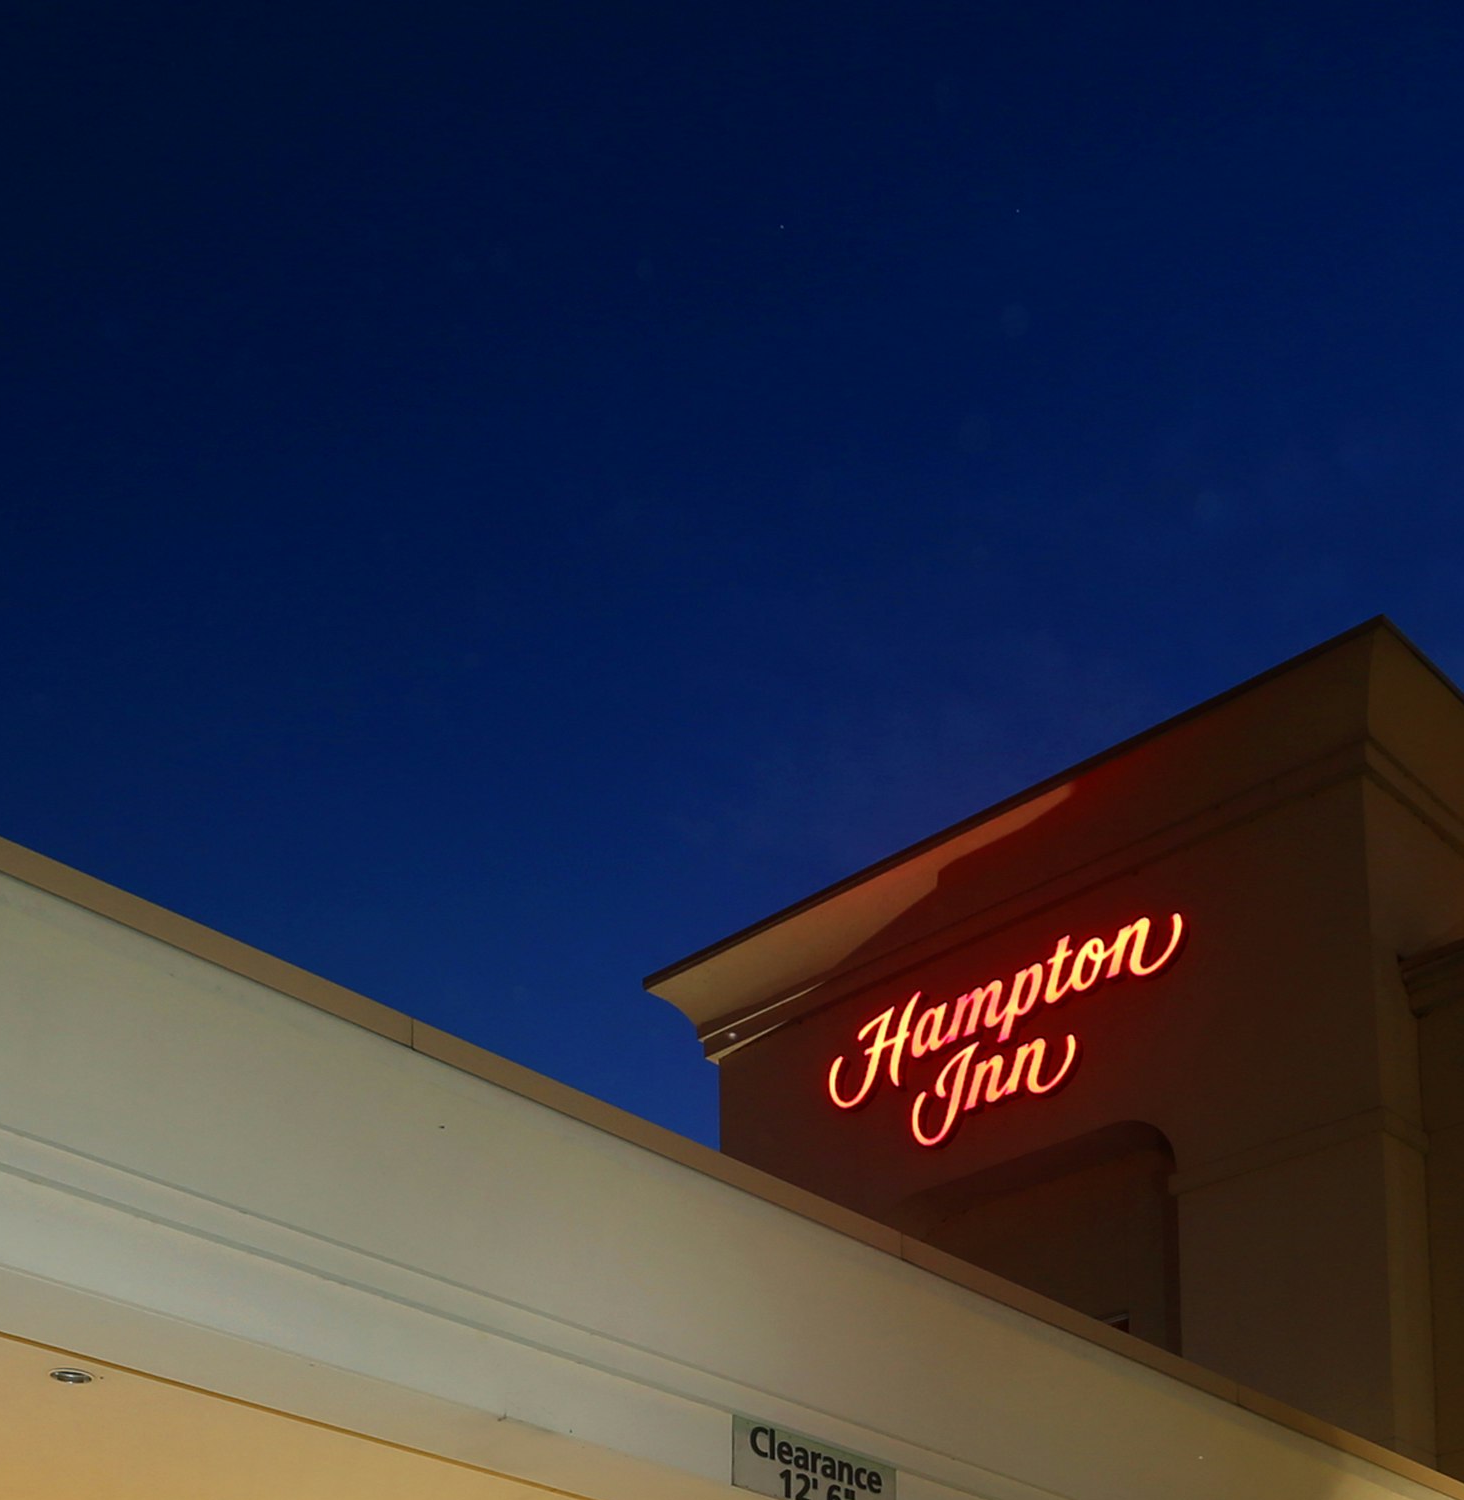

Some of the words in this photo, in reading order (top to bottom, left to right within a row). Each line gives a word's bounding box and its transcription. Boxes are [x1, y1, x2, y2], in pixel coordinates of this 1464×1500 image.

[828, 913, 1183, 1109] Hampton
[911, 1034, 1077, 1146] Inn
[749, 1426, 883, 1494] Clearance
